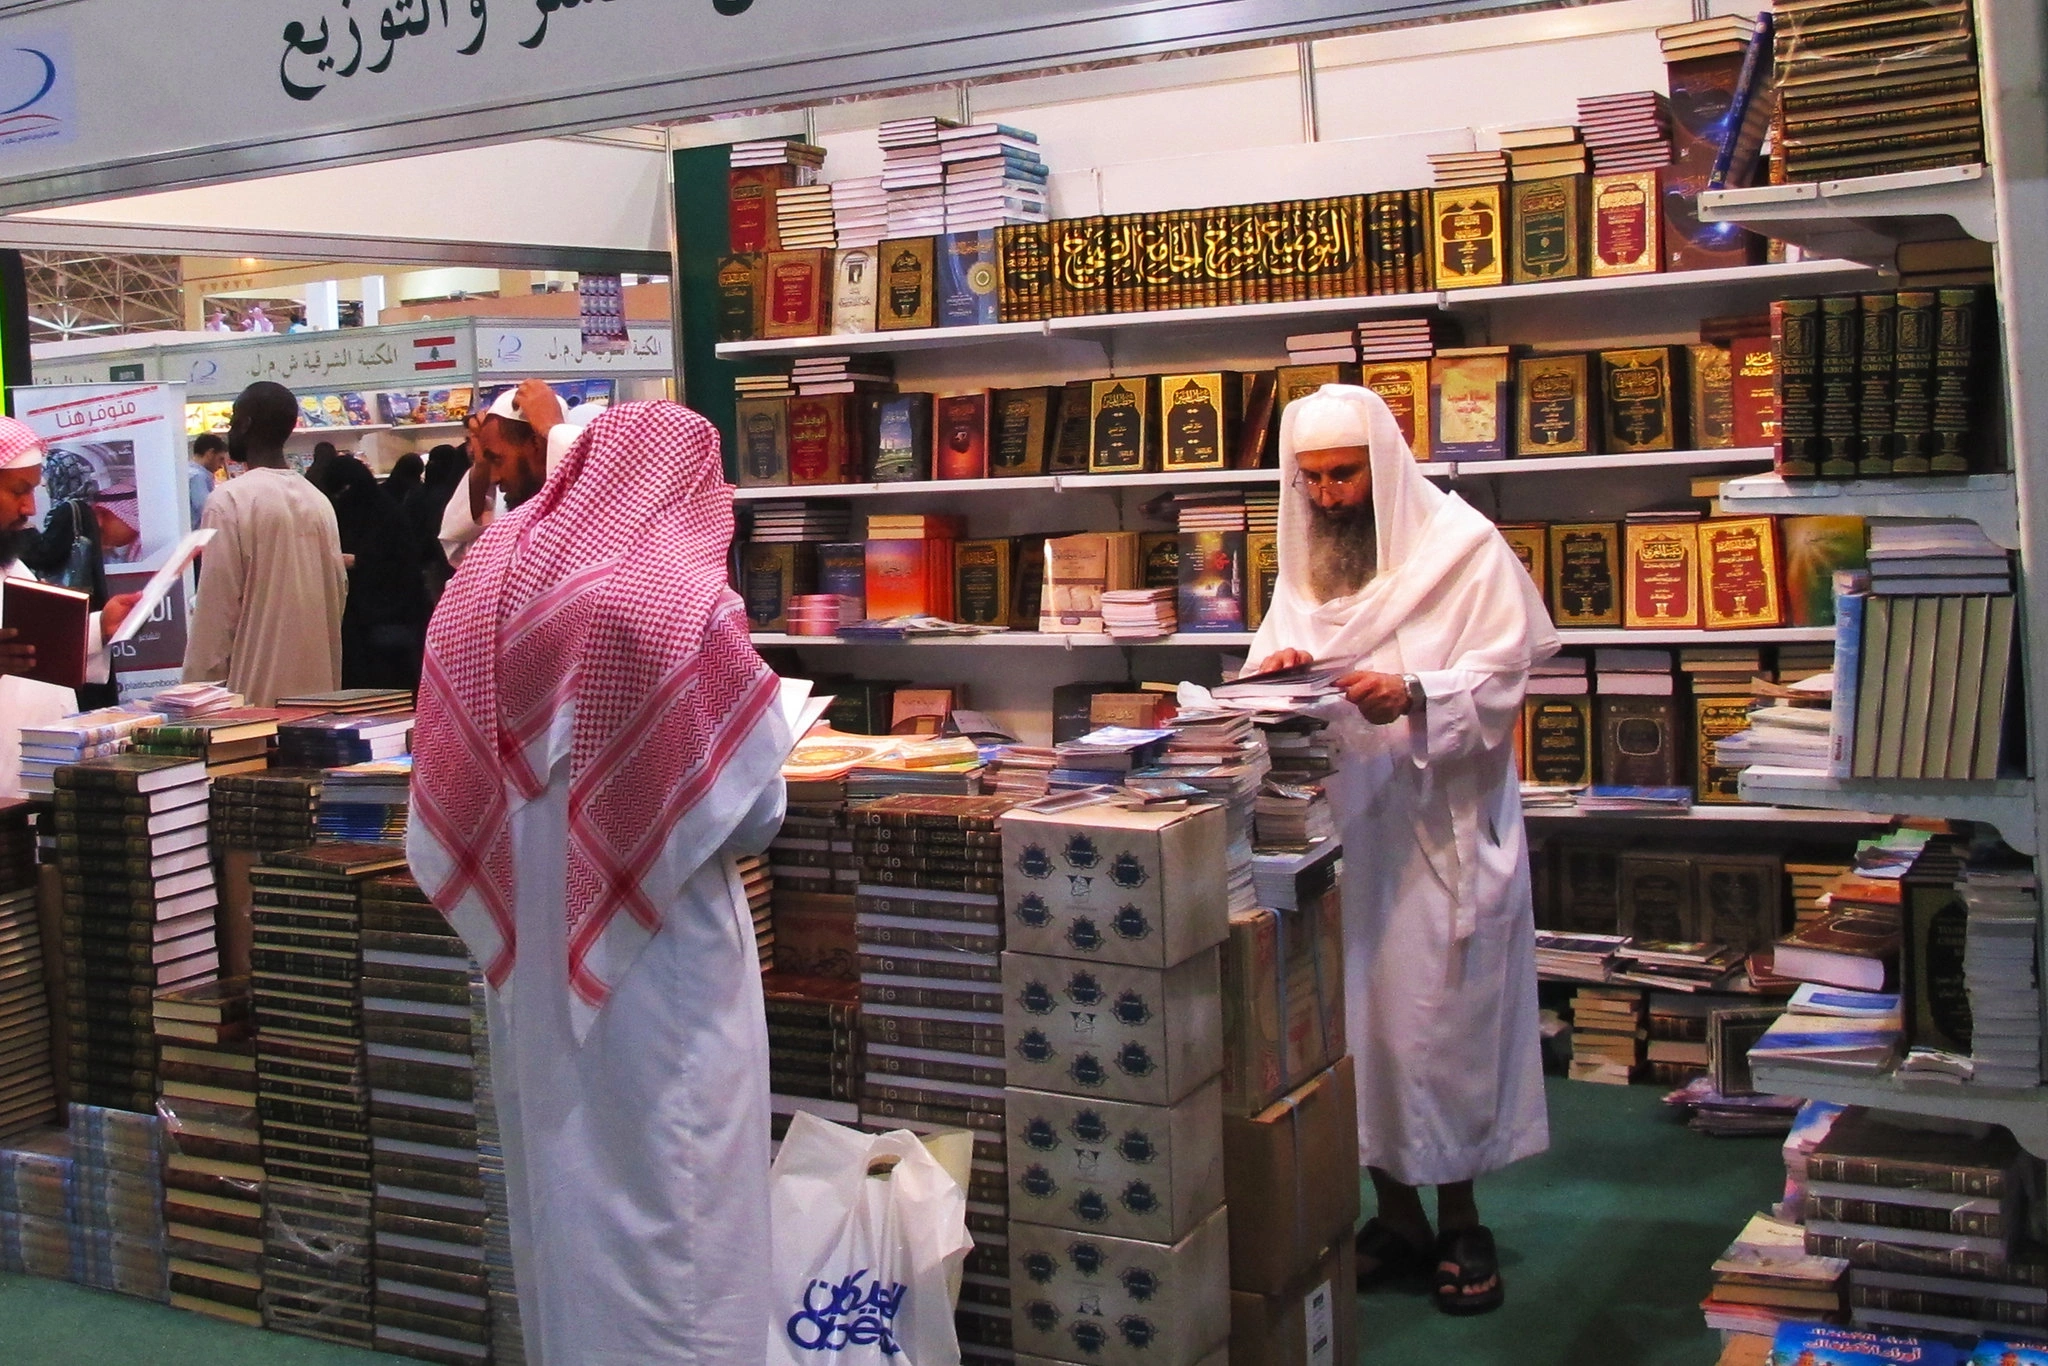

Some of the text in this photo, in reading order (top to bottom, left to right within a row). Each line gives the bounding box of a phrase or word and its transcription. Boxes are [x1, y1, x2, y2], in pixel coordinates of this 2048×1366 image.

[1139, 221, 1201, 284] الجامع
[1263, 207, 1352, 274] التوضيح
[1063, 222, 1138, 289] الصحيح
[304, 348, 351, 376] الشرقية
[358, 343, 398, 369] المكتبة
[633, 336, 661, 360] المكتبة
[479, 358, 493, 368] B54
[55, 400, 136, 428] متوفر هنا
